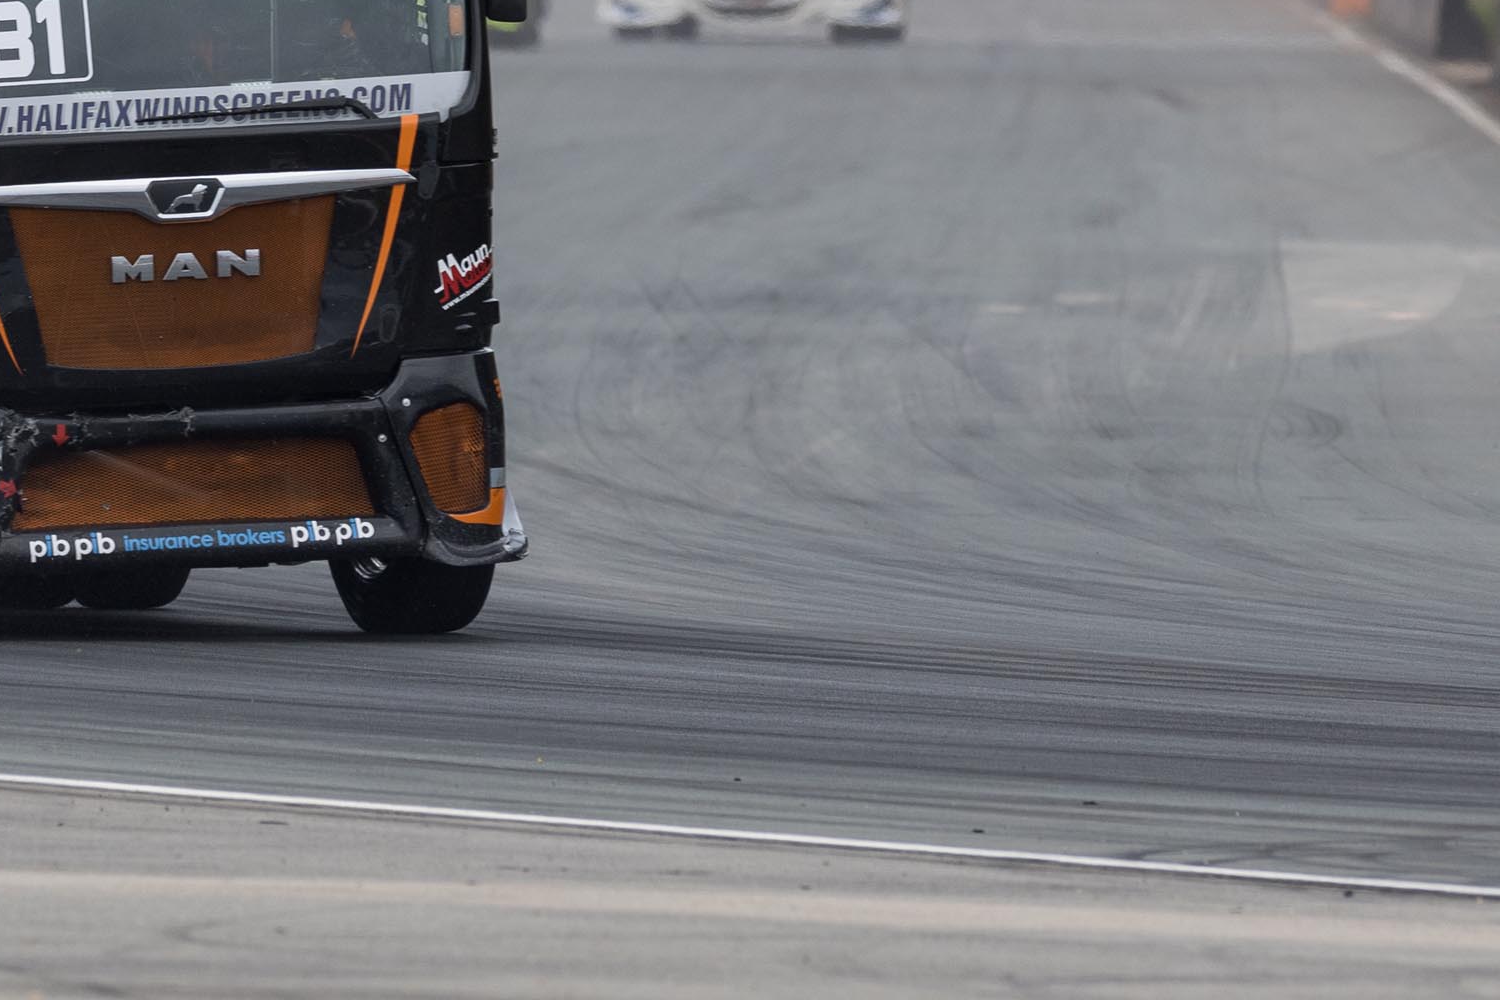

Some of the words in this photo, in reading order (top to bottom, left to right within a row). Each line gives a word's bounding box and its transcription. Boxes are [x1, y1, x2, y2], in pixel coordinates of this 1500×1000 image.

[111, 249, 260, 283] MAN
[434, 243, 492, 294] Maun
[123, 532, 214, 552] insurance
[216, 527, 287, 548] brokers
